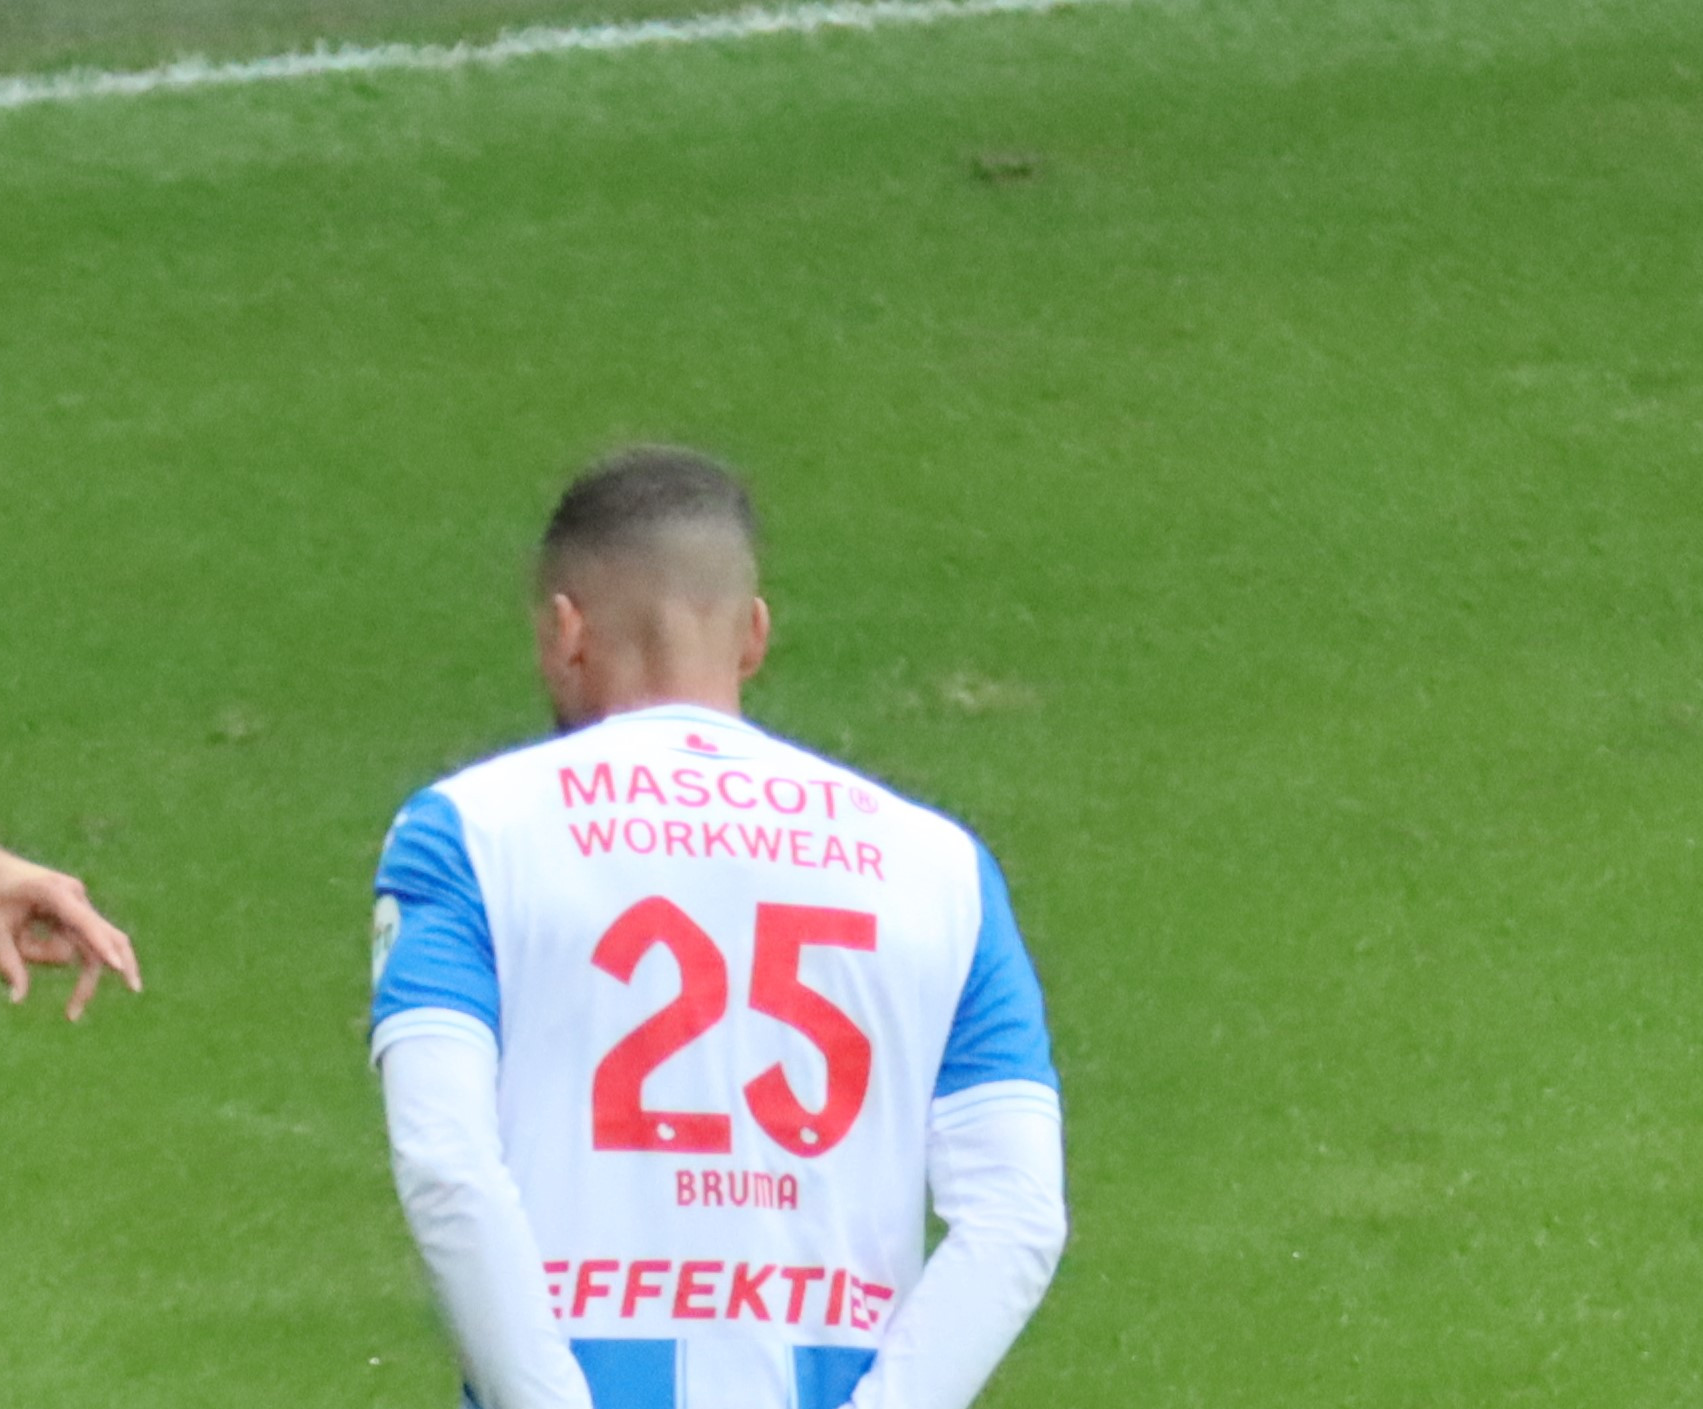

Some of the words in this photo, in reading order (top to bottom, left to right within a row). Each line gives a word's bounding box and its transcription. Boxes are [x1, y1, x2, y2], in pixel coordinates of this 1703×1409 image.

[568, 817, 885, 882] WORKWEAR
[590, 894, 878, 1159] 25
[675, 1169, 799, 1211] BRUMA
